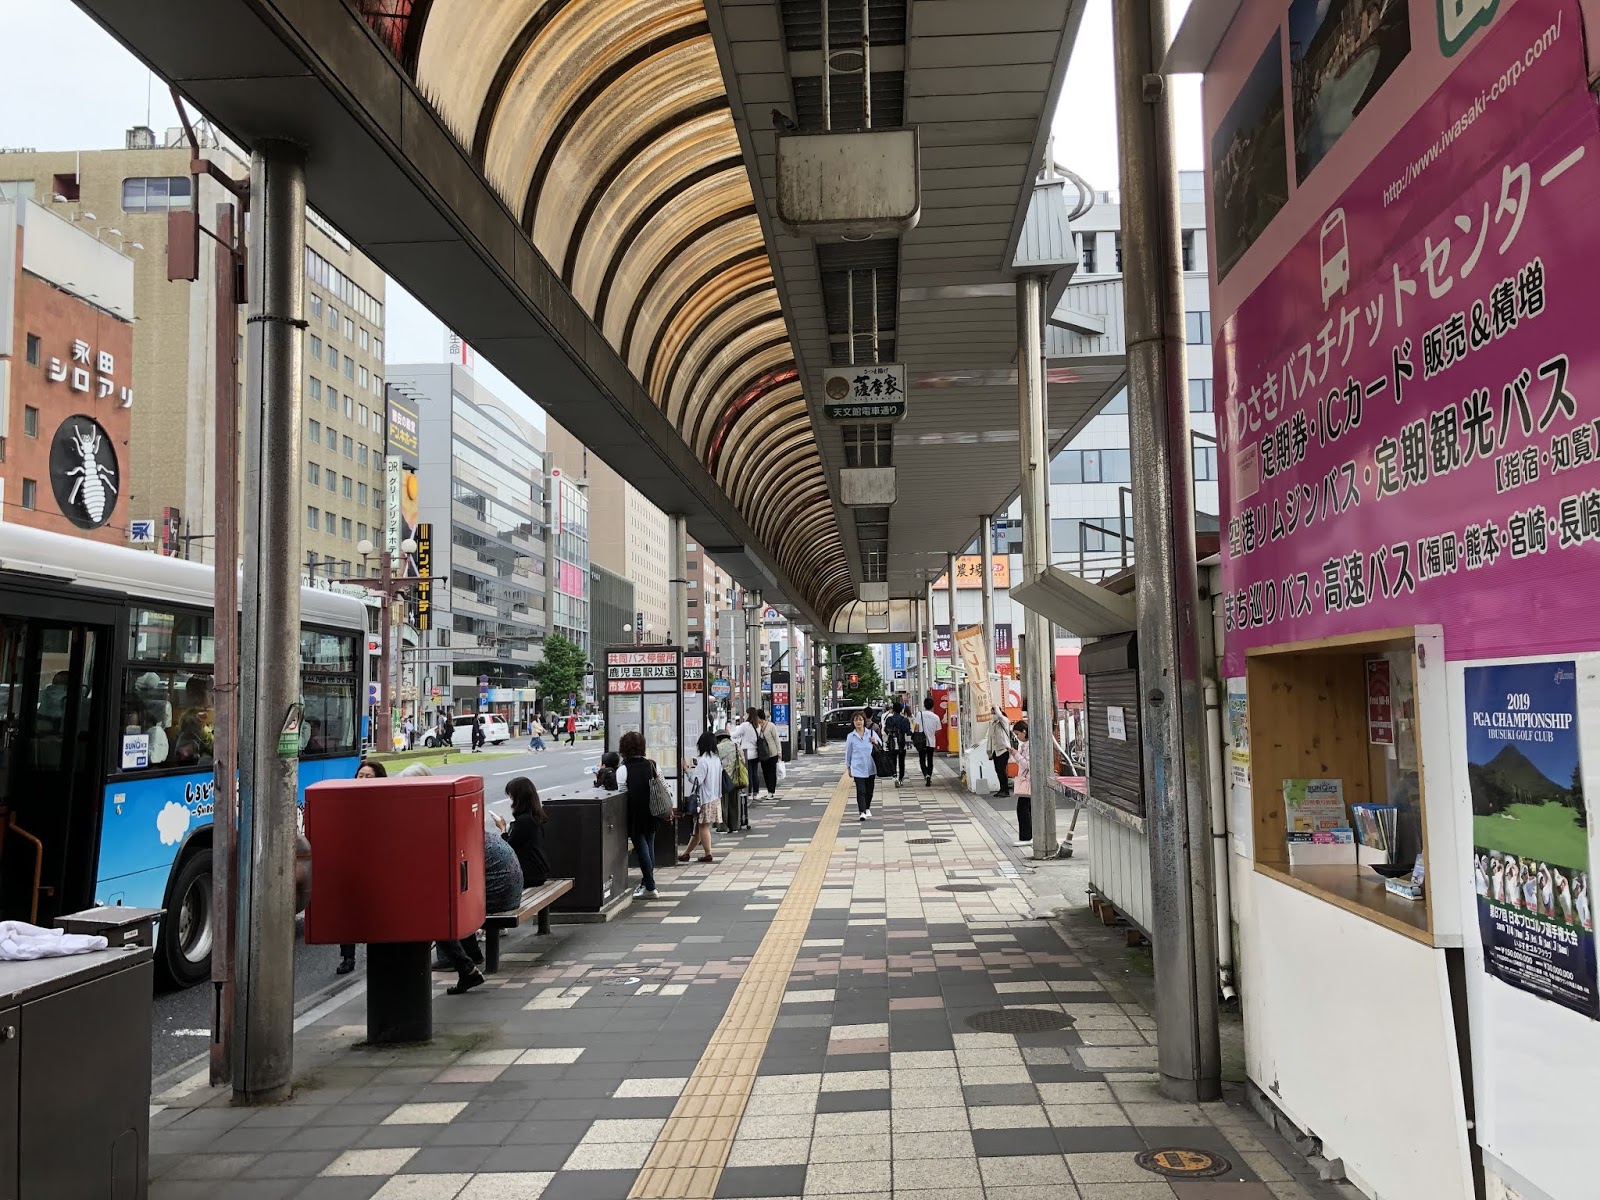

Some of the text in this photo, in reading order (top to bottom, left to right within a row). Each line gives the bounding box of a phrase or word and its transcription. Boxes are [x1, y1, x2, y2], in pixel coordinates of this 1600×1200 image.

[1382, 10, 1562, 208] http://www.iwasaki-corp.com/
[1219, 145, 1585, 453] いわさきバスチケットセンター
[73, 337, 114, 376] 永田
[48, 356, 133, 409] シロアリ
[833, 406, 897, 417] 天文館電車通り
[1260, 339, 1414, 482] 定期券・ICカード
[1228, 354, 1577, 560] 空港リムジンバス・定期観光バス
[609, 652, 676, 664] 共同バス停留所
[684, 657, 702, 667] 留所
[609, 667, 676, 678] 鹿児島駅以遠
[895, 671, 903, 679] P
[608, 681, 642, 691] 市営バス
[481, 697, 488, 705] P
[1507, 693, 1530, 710] 2019
[1473, 711, 1573, 729] PGA CHAMPIONSHIP
[1488, 729, 1553, 742] IBUSUKI GOLF CLUB
